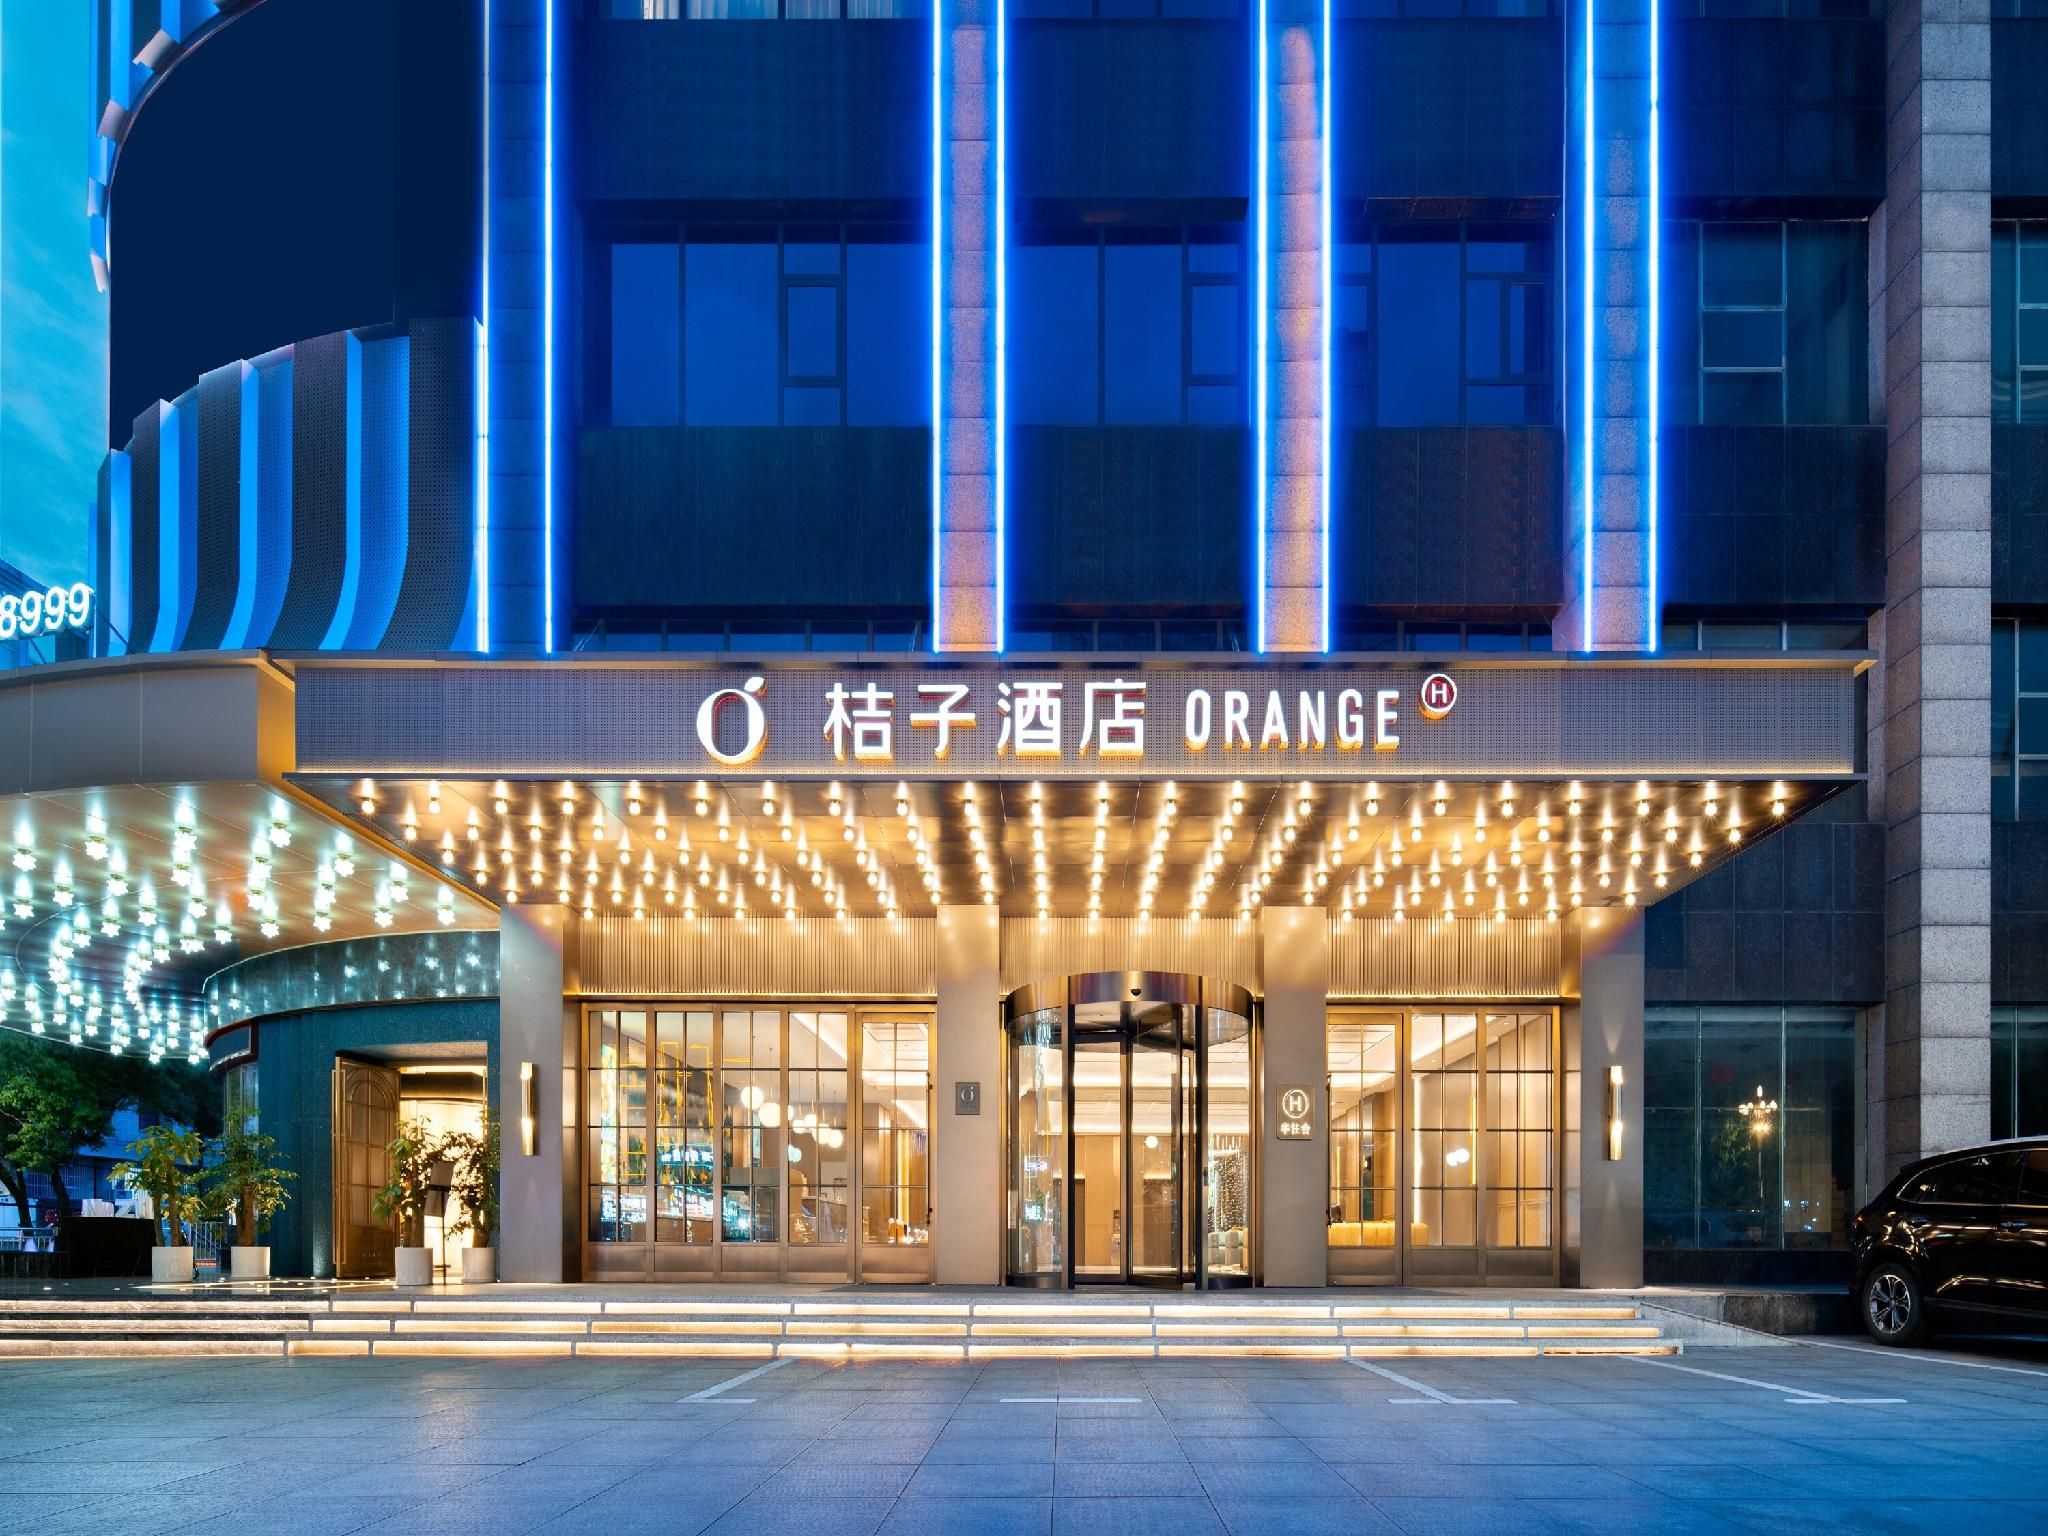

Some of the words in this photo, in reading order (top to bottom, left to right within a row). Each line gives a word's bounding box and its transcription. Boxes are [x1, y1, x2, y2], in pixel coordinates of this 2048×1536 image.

[0, 583, 94, 638] 8999
[824, 679, 1147, 759] 桔子酒店
[1185, 688, 1400, 750] ORANGE
